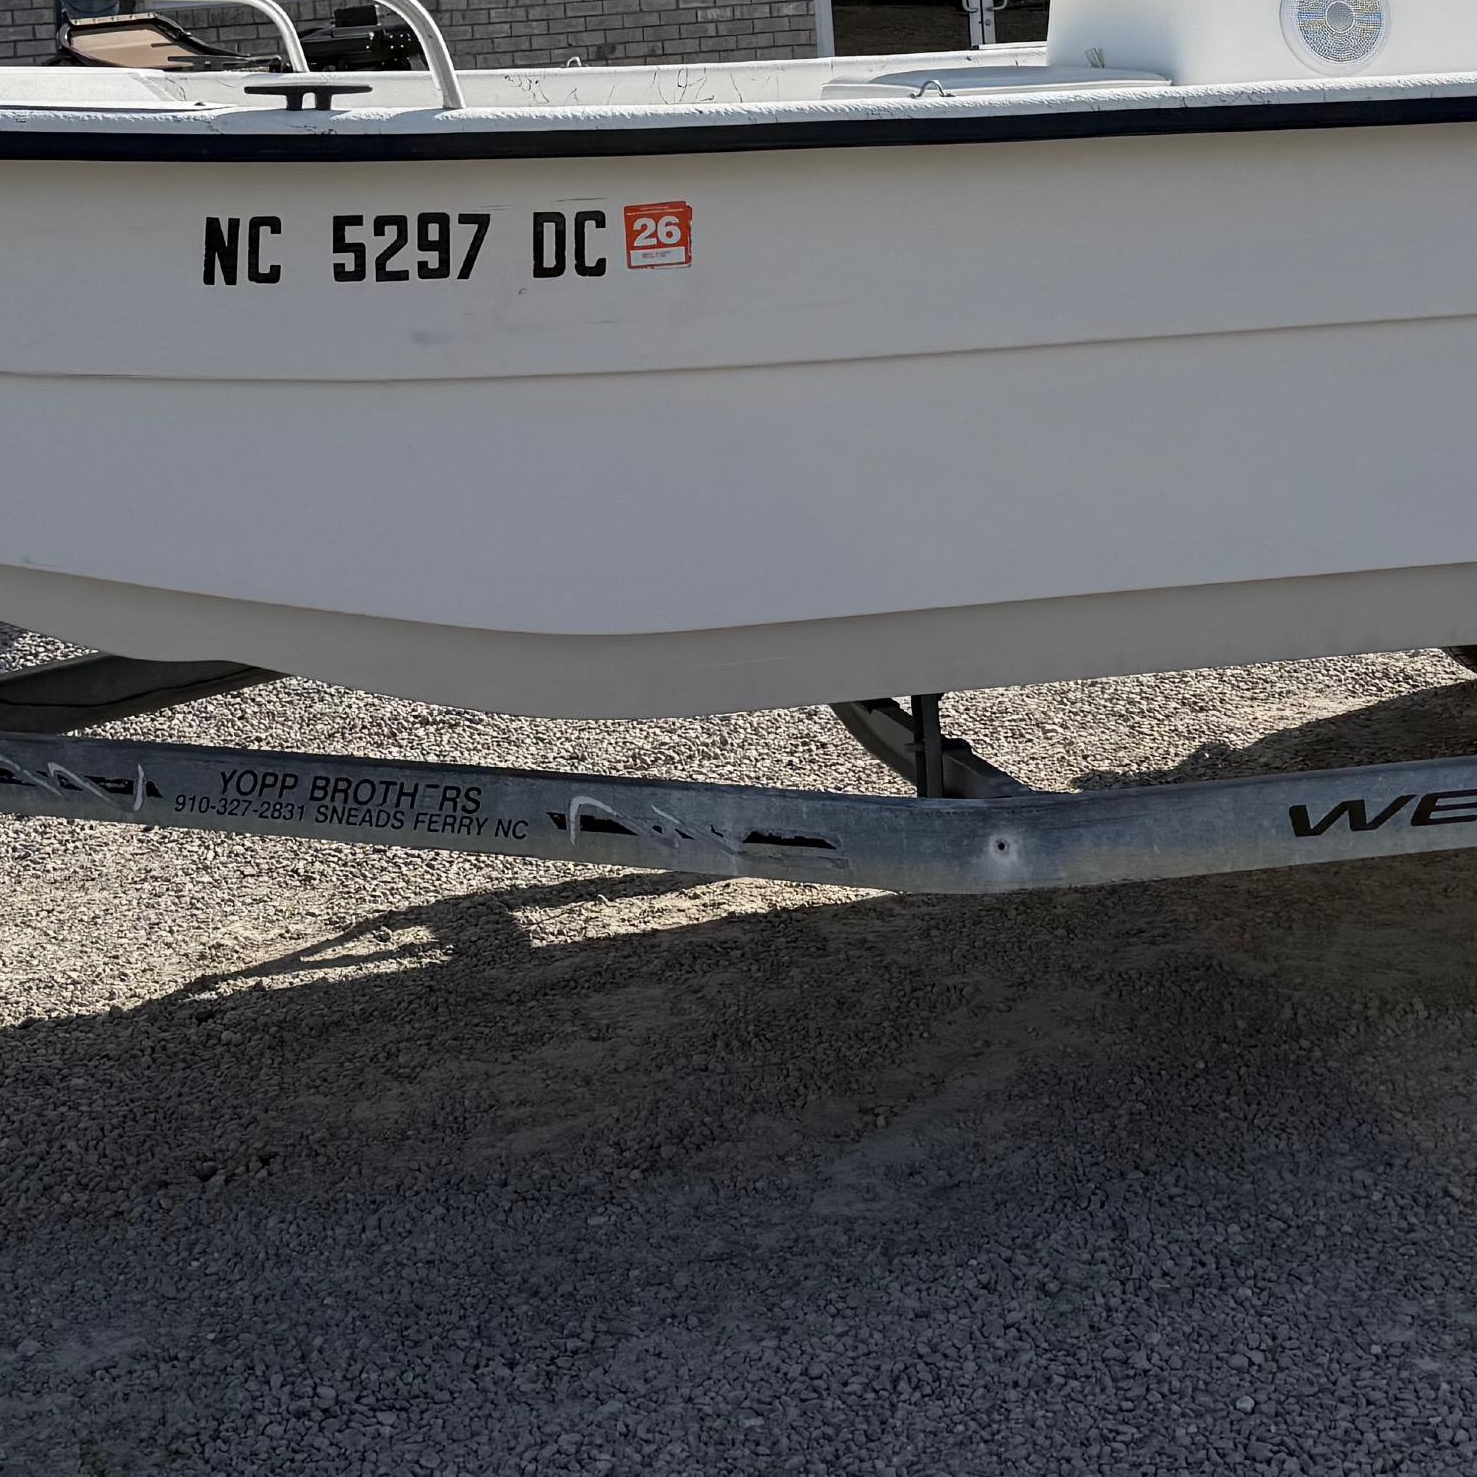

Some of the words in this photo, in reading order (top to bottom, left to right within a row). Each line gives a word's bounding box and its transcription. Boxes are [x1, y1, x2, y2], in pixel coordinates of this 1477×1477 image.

[202, 216, 282, 286] NC
[332, 212, 491, 283] 5297
[532, 210, 607, 279] DC
[633, 215, 682, 247] 26
[220, 769, 299, 799] YOPP
[174, 794, 305, 822] 910-327-2831
[315, 804, 405, 830] SNEADS
[413, 812, 489, 836] FERRY
[495, 820, 529, 840] NC
